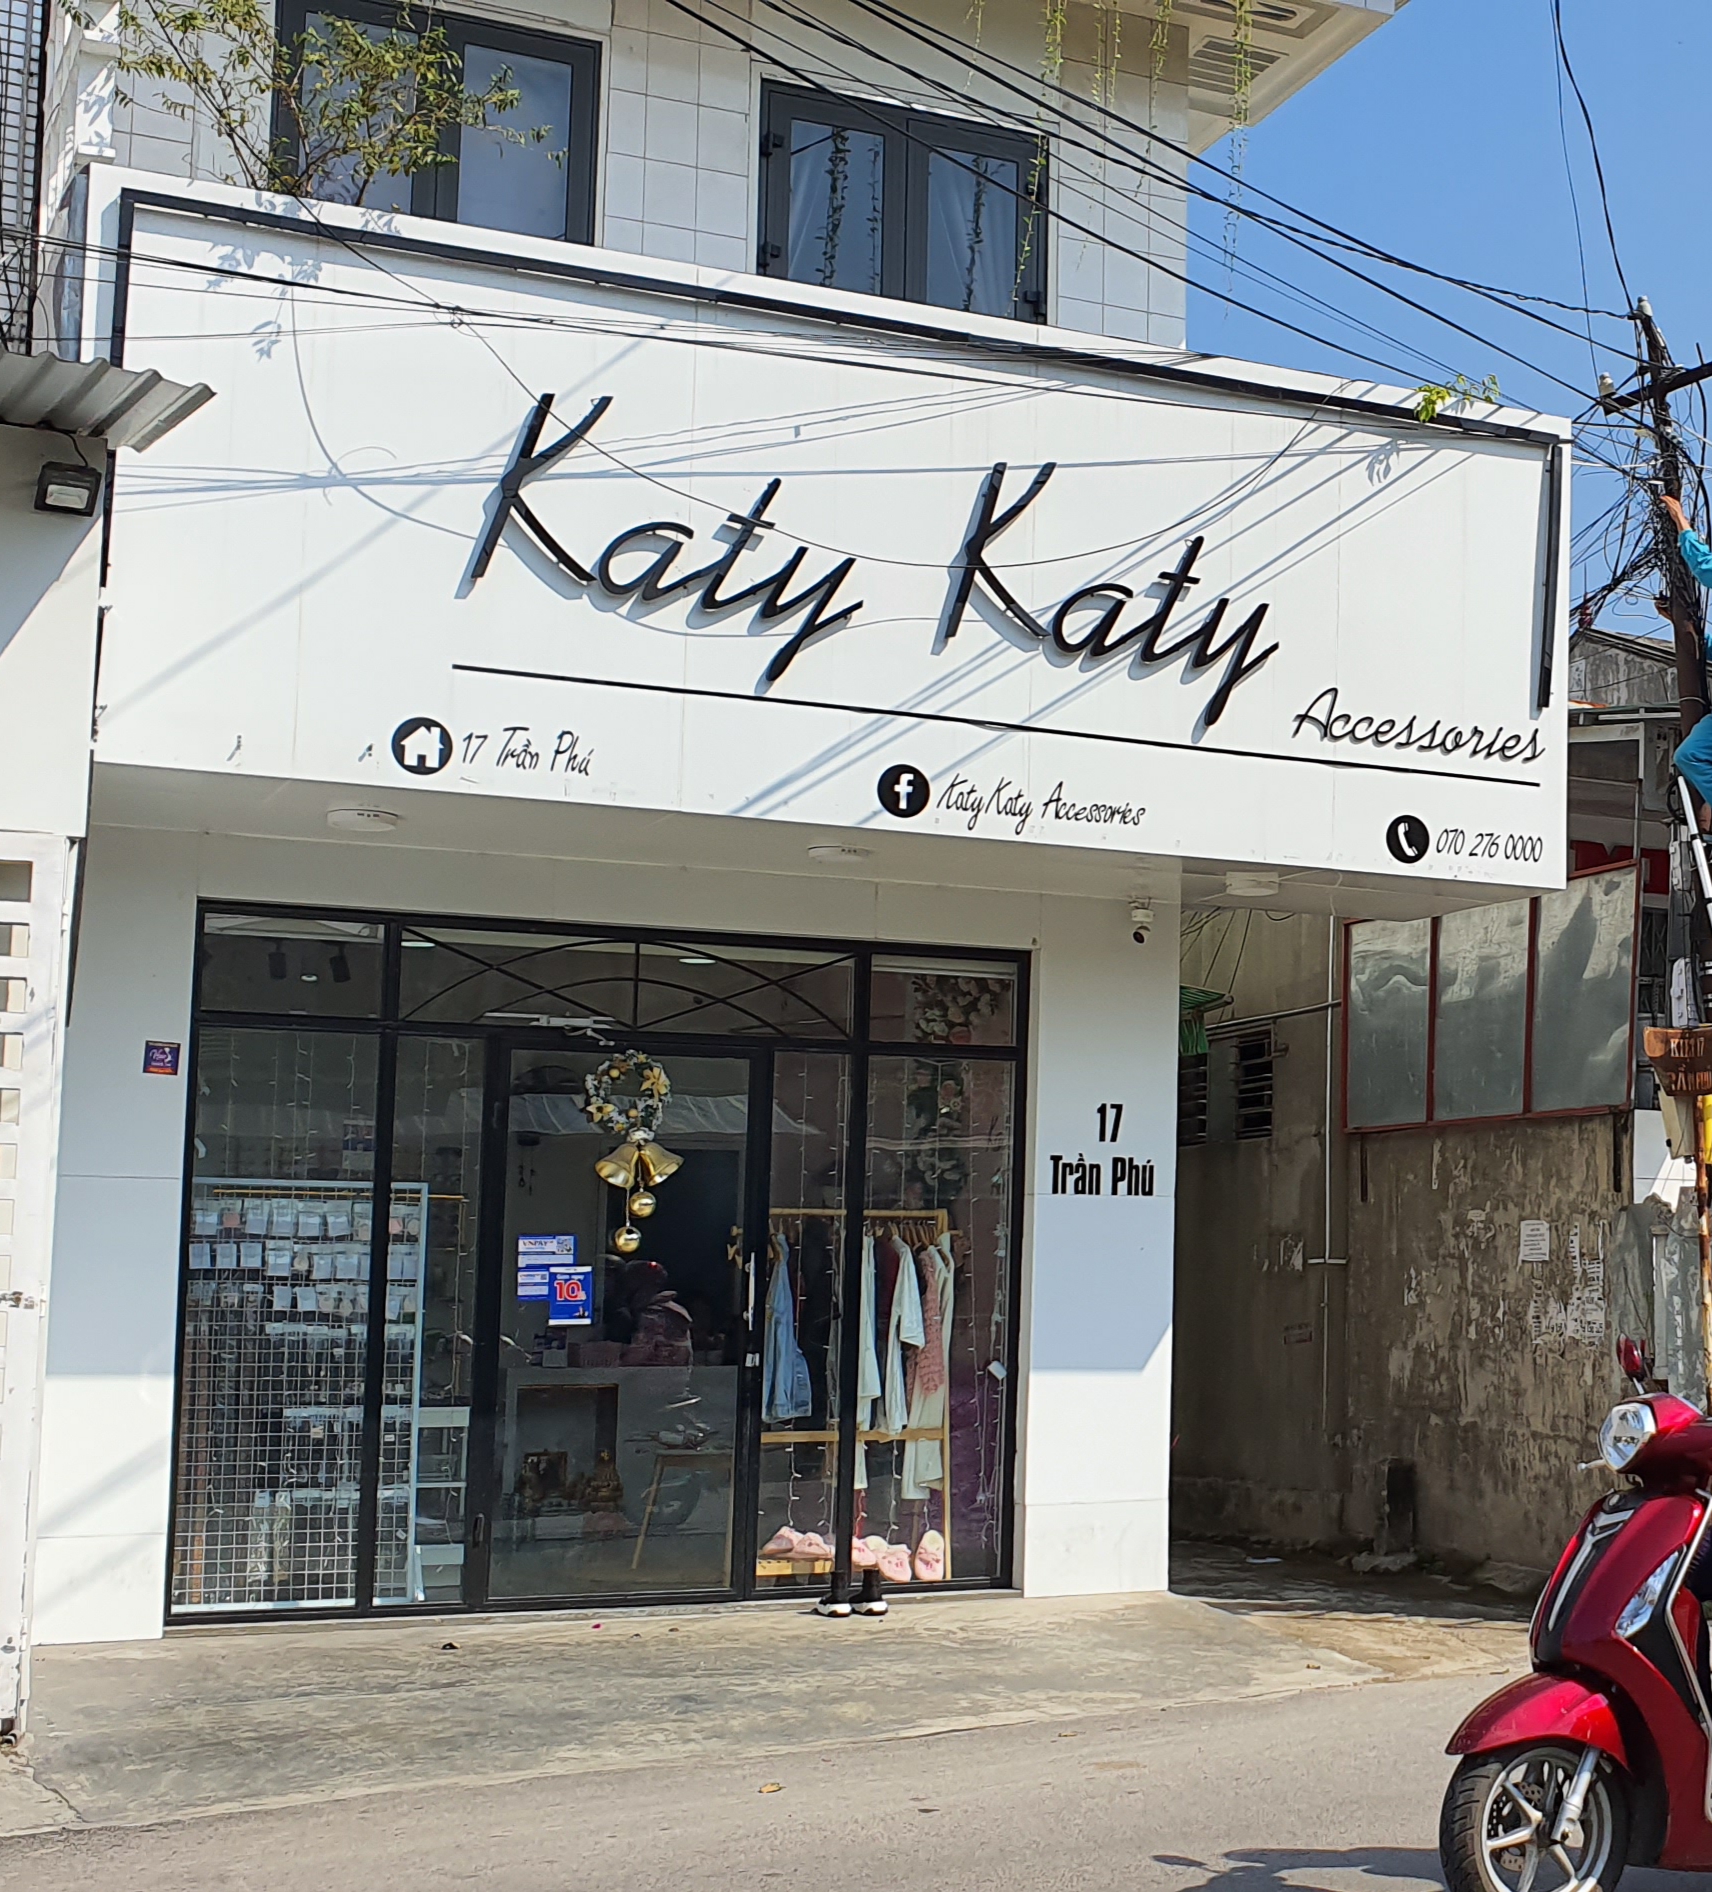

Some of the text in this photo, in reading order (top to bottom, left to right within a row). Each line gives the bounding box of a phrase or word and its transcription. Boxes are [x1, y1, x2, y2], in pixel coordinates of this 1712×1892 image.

[472, 393, 1279, 727] Katy Katy
[1292, 687, 1546, 764] Accessories
[462, 726, 595, 777] 17 Trần Phú
[936, 773, 1147, 836] Katy Katy Accessories
[1436, 828, 1544, 863] 070 276 0000
[1096, 1103, 1124, 1143] 17
[1050, 1153, 1155, 1197] Trần Phú
